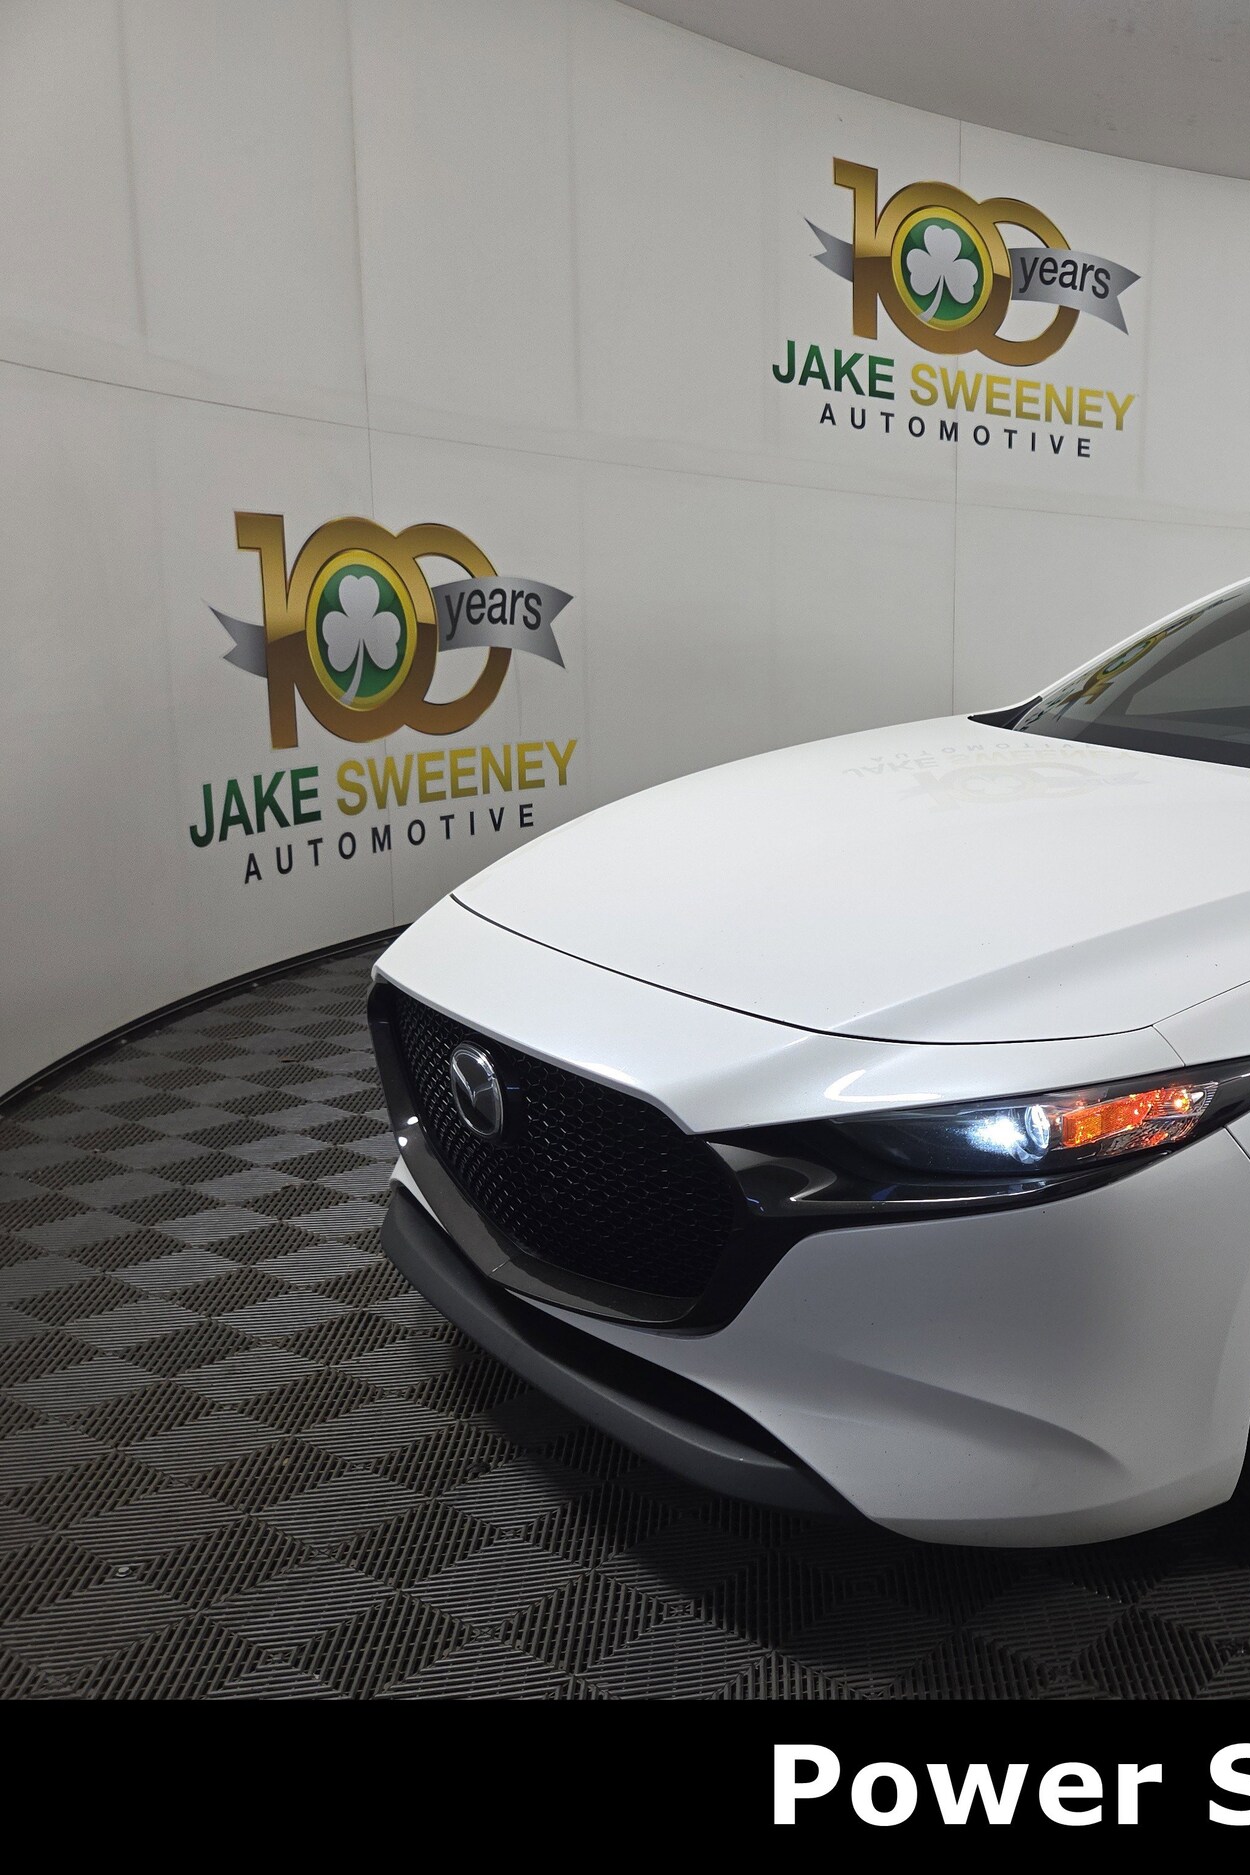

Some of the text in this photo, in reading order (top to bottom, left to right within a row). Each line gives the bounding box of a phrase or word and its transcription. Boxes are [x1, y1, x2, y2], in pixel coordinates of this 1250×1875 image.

[833, 157, 1111, 367] 100 years
[772, 340, 1134, 431] JAKE SWEENEY
[819, 403, 1091, 458] AUTOMOTIVE
[234, 511, 542, 750] 100 years
[189, 739, 577, 848] JAKE SWEENEY
[244, 803, 534, 884] AUTOMOTIVE
